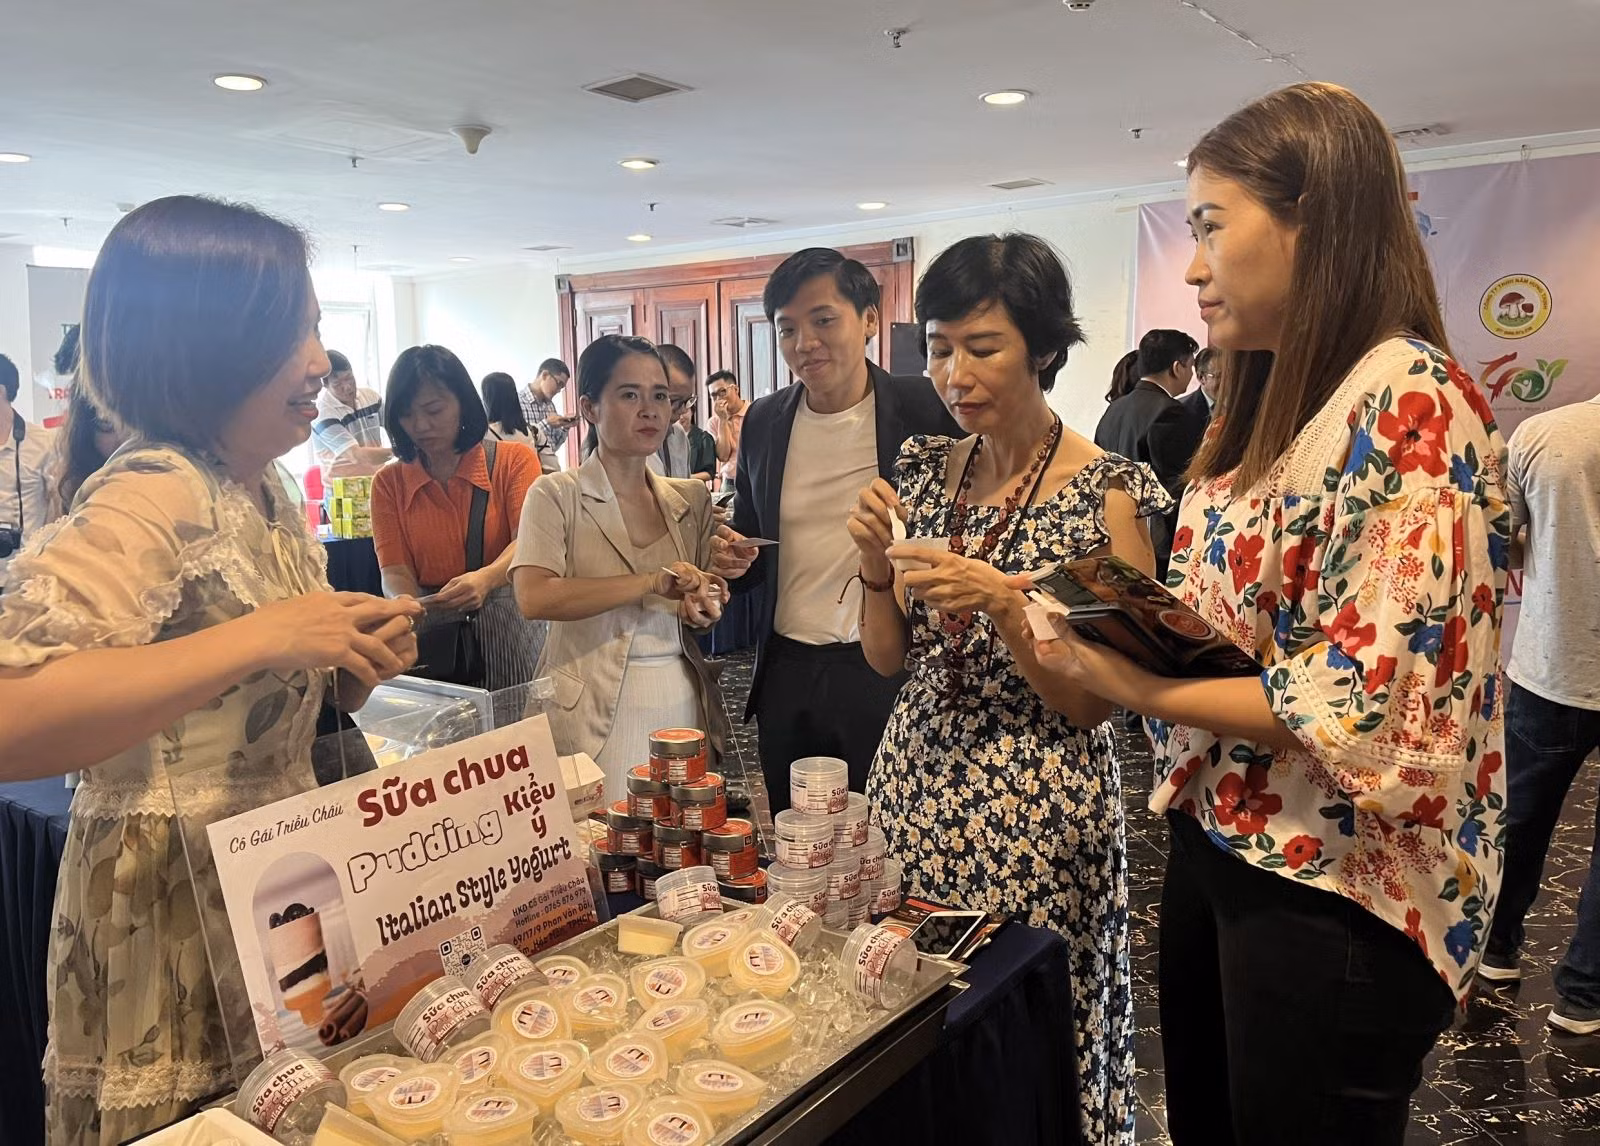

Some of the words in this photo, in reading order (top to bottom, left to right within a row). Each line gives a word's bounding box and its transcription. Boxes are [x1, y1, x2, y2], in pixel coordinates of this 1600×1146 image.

[357, 776, 437, 827] Sữa
[443, 745, 530, 795] chua
[503, 772, 556, 816] Kiểu
[229, 836, 246, 854] Cô
[250, 828, 274, 847] Gái
[312, 804, 344, 824] Châu
[347, 810, 503, 894] Pudding
[860, 855, 871, 865] ữa
[376, 891, 456, 946] Italian
[456, 866, 507, 908] Style
[508, 836, 572, 883] Yogurt
[512, 903, 528, 917] HKD
[515, 911, 540, 928] Hotline
[544, 900, 561, 914] 0765
[574, 887, 586, 897] 979
[542, 916, 562, 930] Phan
[476, 970, 495, 991] Sữa
[495, 955, 521, 972] chua
[422, 1002, 445, 1023] Sữa
[445, 989, 470, 1004] chua
[252, 1087, 272, 1115] Sữa
[272, 1064, 304, 1088] chua
